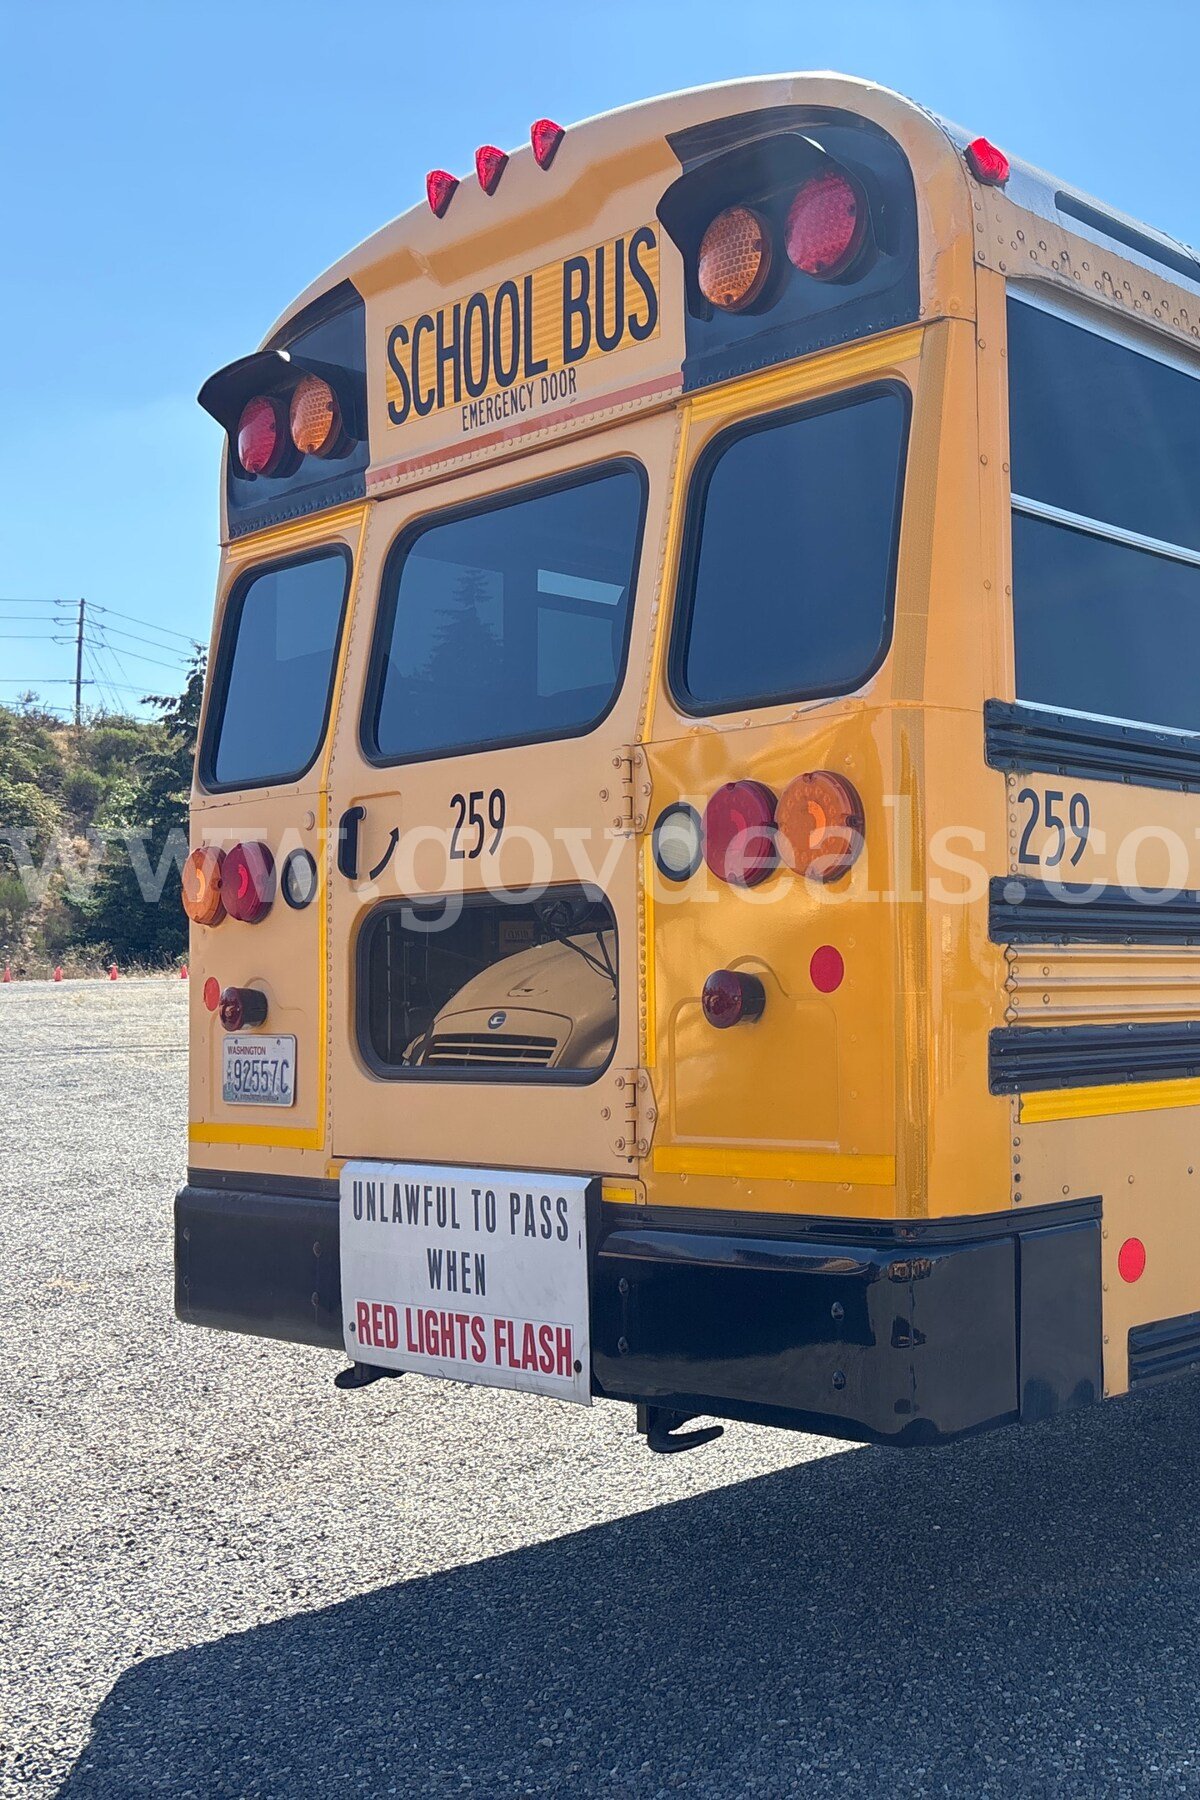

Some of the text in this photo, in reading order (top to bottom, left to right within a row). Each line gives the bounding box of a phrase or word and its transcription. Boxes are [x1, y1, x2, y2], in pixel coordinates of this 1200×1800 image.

[387, 226, 659, 426] SCHOOL BUS
[461, 367, 578, 432] EMERGENCY DOOR
[449, 788, 506, 860] 259
[1017, 787, 1091, 867] 259
[227, 1046, 267, 1055] WASHINGTON
[234, 1059, 290, 1094] 92557C
[352, 1180, 569, 1242] UNLAWFUL TO PASS
[426, 1247, 487, 1297] WHEN
[356, 1300, 573, 1378] RED LIGHTS FLASH
